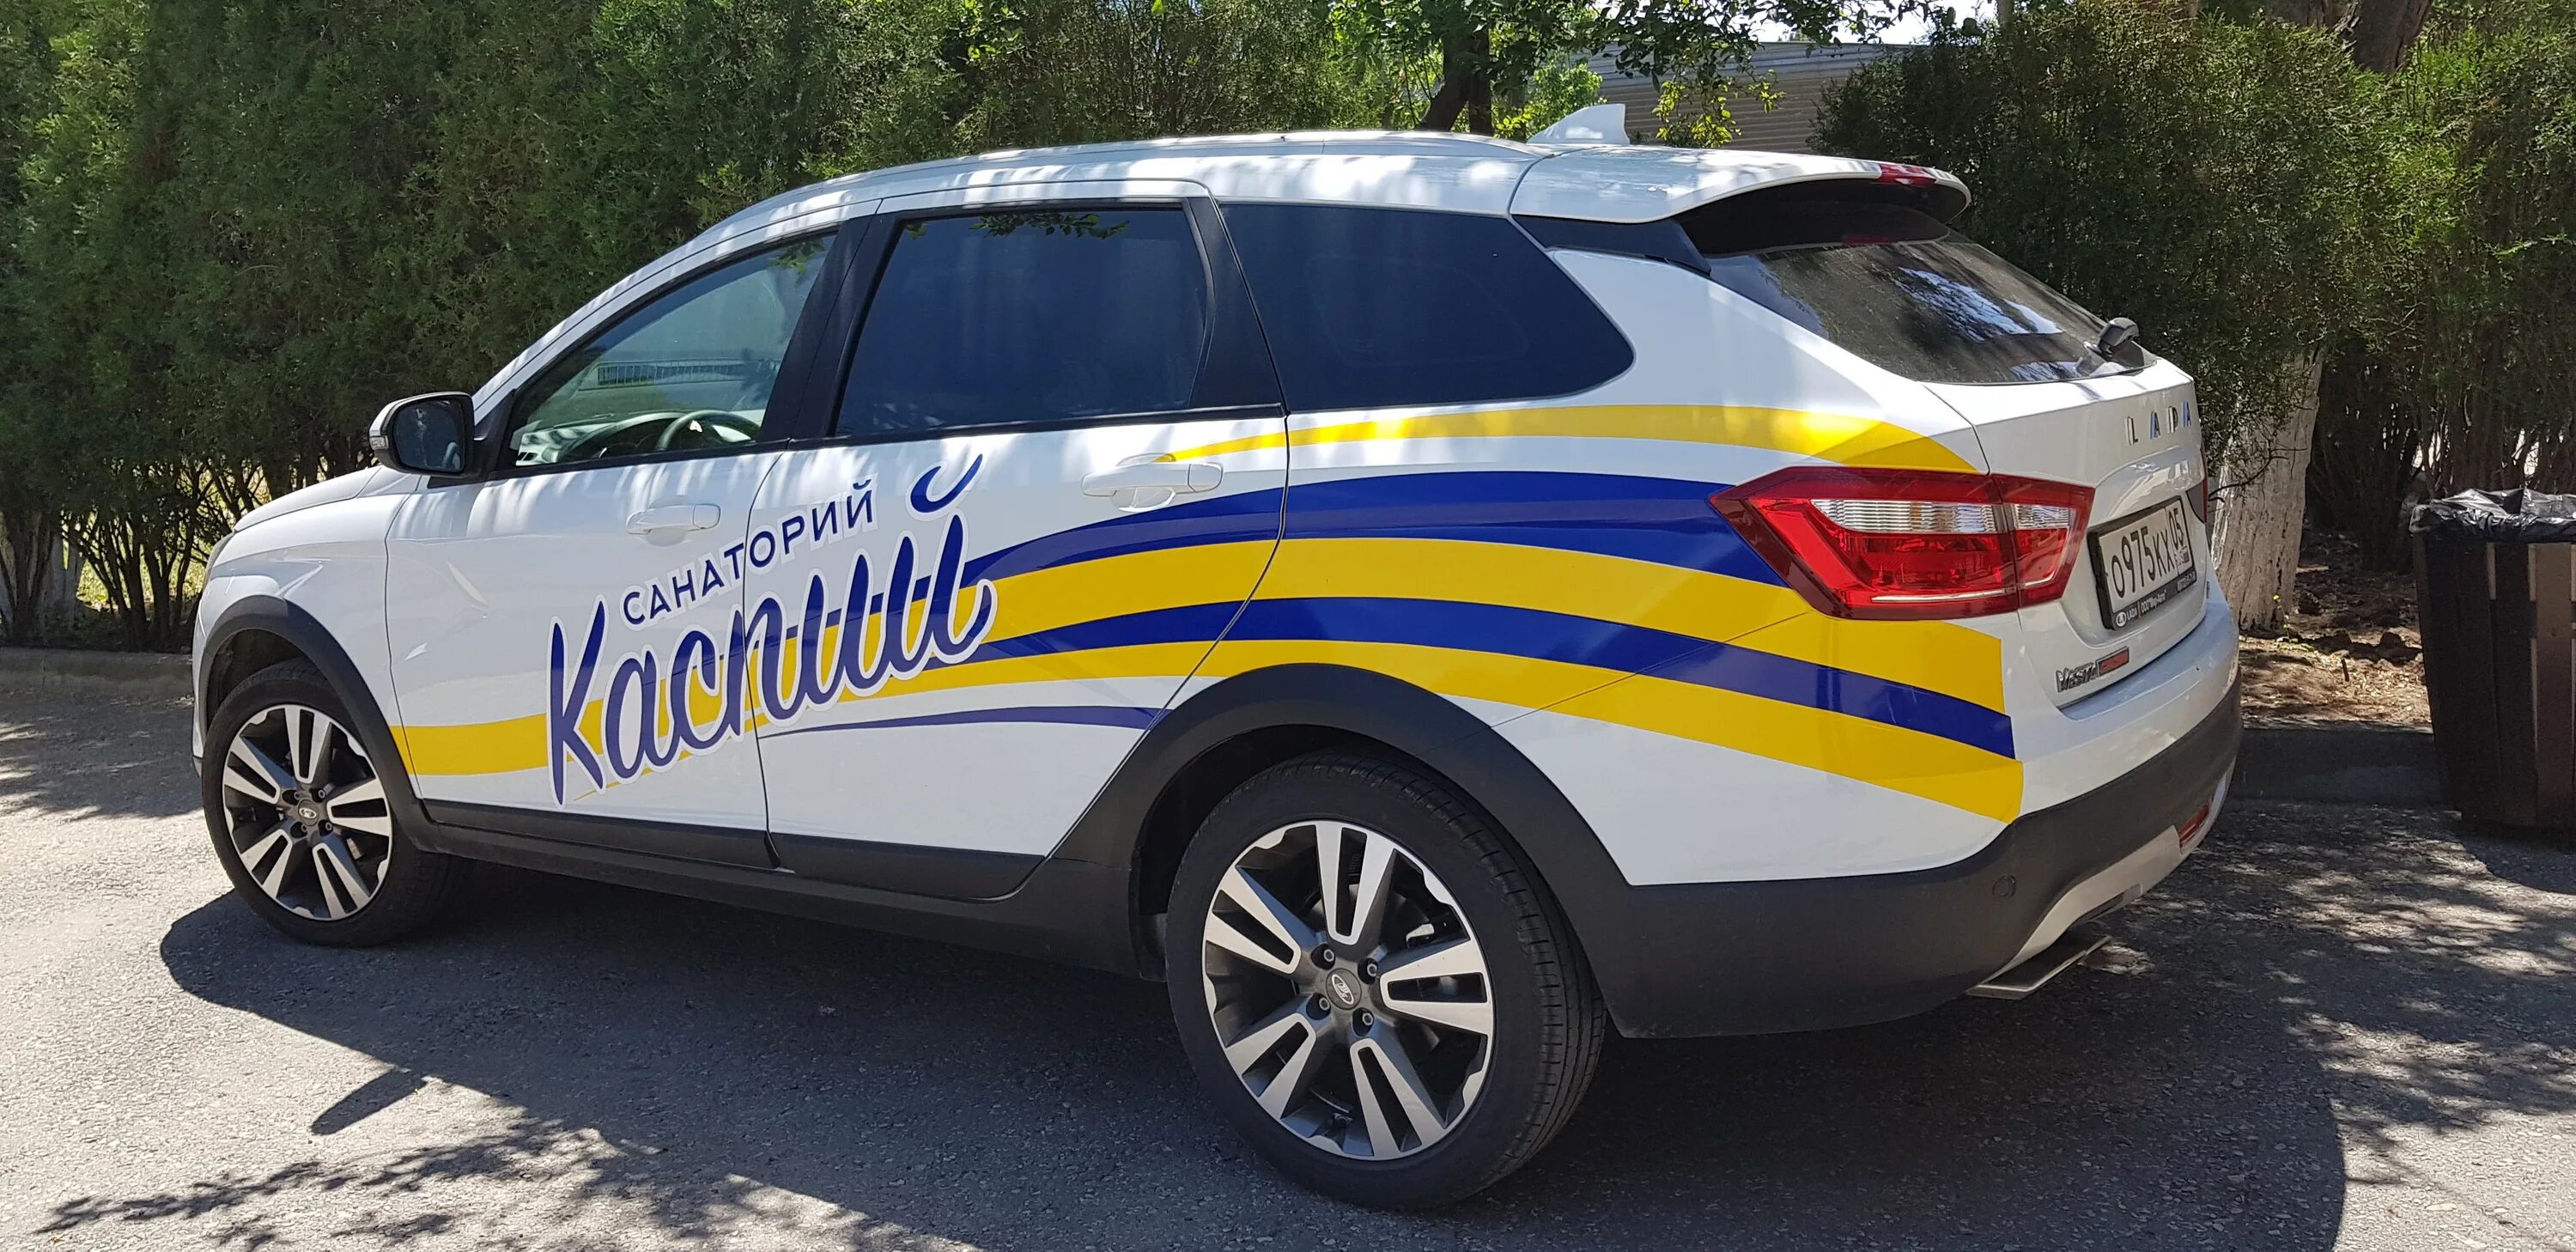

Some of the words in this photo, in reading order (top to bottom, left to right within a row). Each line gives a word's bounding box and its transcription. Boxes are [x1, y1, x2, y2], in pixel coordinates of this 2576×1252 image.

[2126, 400, 2192, 446] LADA
[623, 478, 873, 625] САНАТОРИЙ
[549, 453, 993, 806] Каспий
